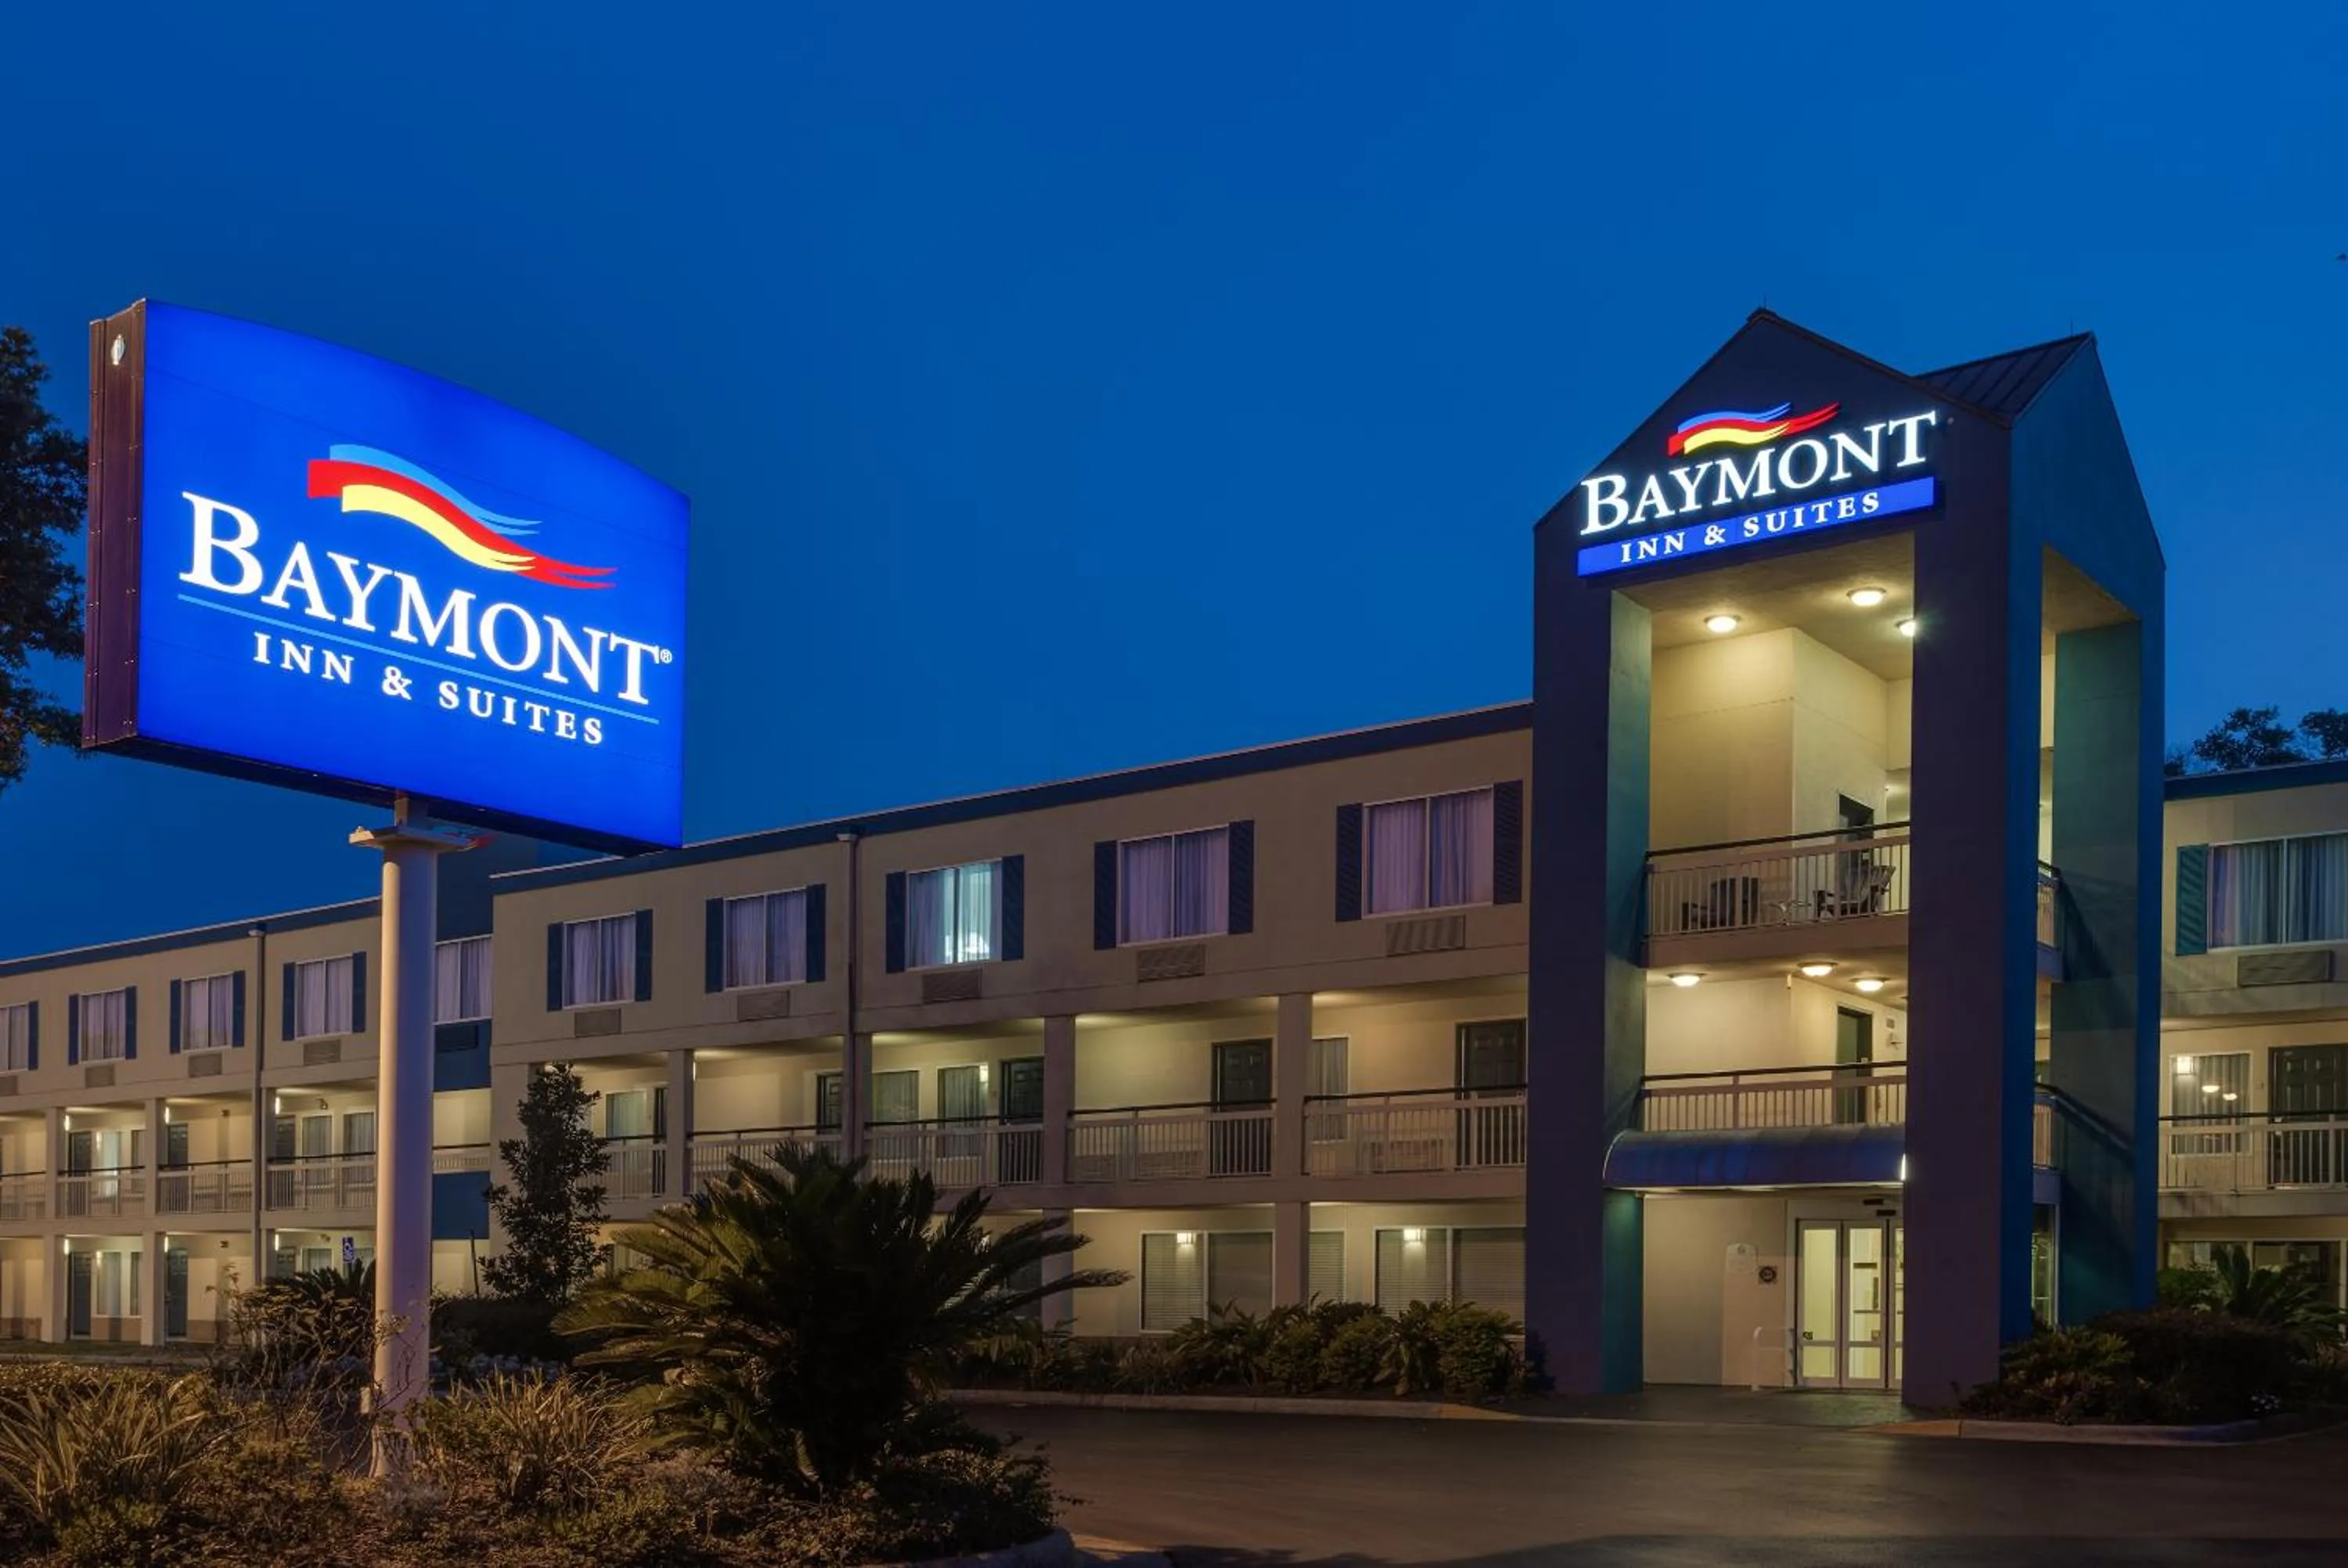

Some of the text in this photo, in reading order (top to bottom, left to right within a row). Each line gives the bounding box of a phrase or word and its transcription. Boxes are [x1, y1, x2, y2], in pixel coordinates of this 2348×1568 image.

[1579, 410, 1937, 536] BAYMONT
[1621, 492, 1879, 563] INN & SUITES
[254, 631, 603, 745] INN & SUITES
